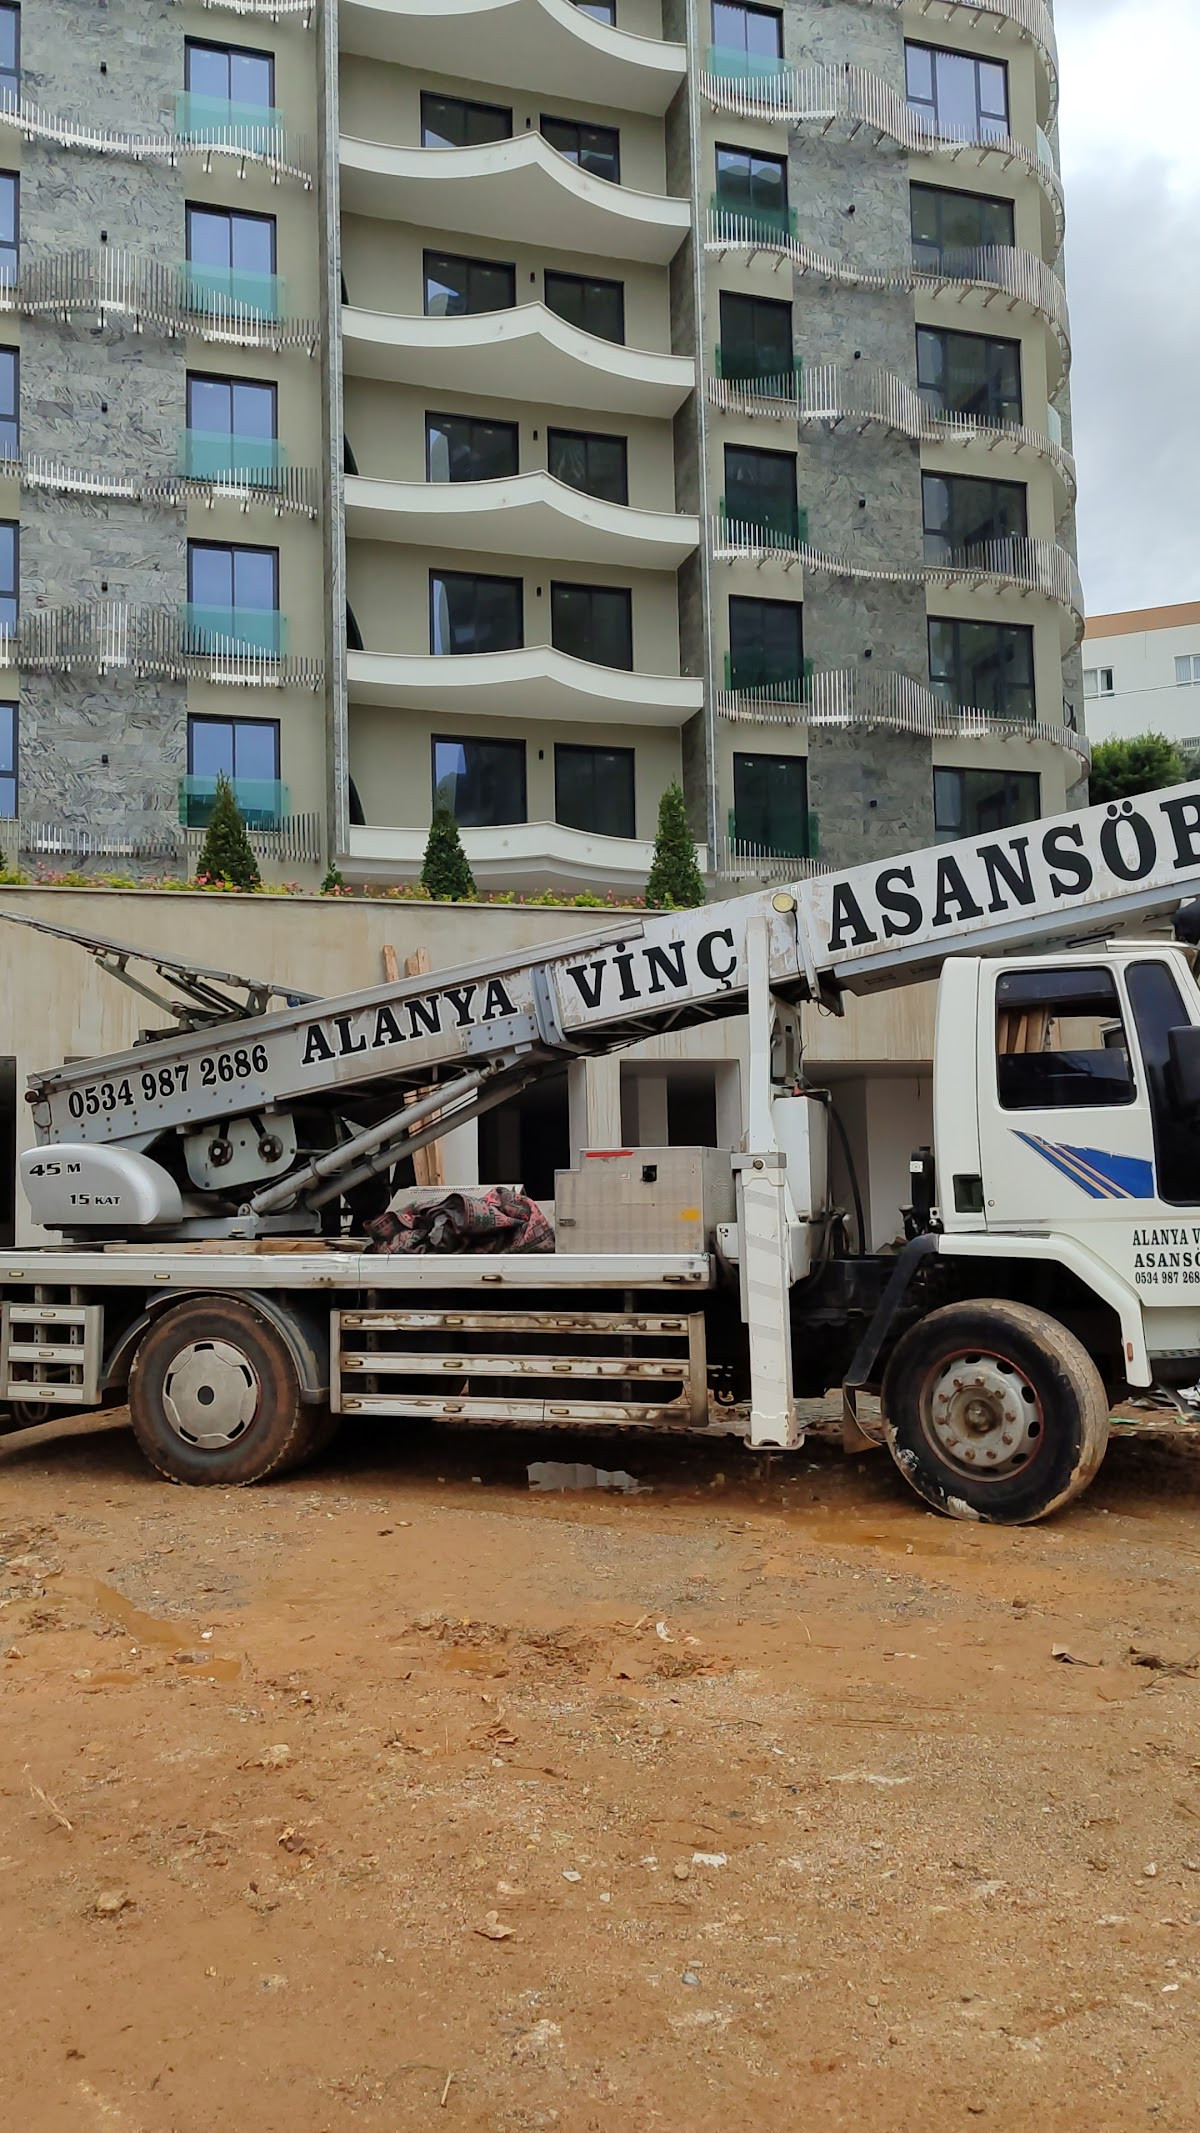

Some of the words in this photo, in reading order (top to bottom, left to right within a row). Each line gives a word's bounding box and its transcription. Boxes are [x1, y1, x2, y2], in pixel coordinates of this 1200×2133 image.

[302, 980, 517, 1064] ALANYA
[566, 928, 738, 1009] VİNÇ
[68, 1080, 134, 1119] 0534
[141, 1063, 190, 1101] 987
[200, 1044, 269, 1087] 2686
[29, 1162, 61, 1177] 45
[67, 1163, 81, 1173] M
[70, 1194, 90, 1205] 15
[95, 1196, 121, 1205] KAT
[1133, 1229, 1189, 1246] ALANYA
[1135, 1271, 1159, 1284] 0534
[1161, 1271, 1179, 1284] 987
